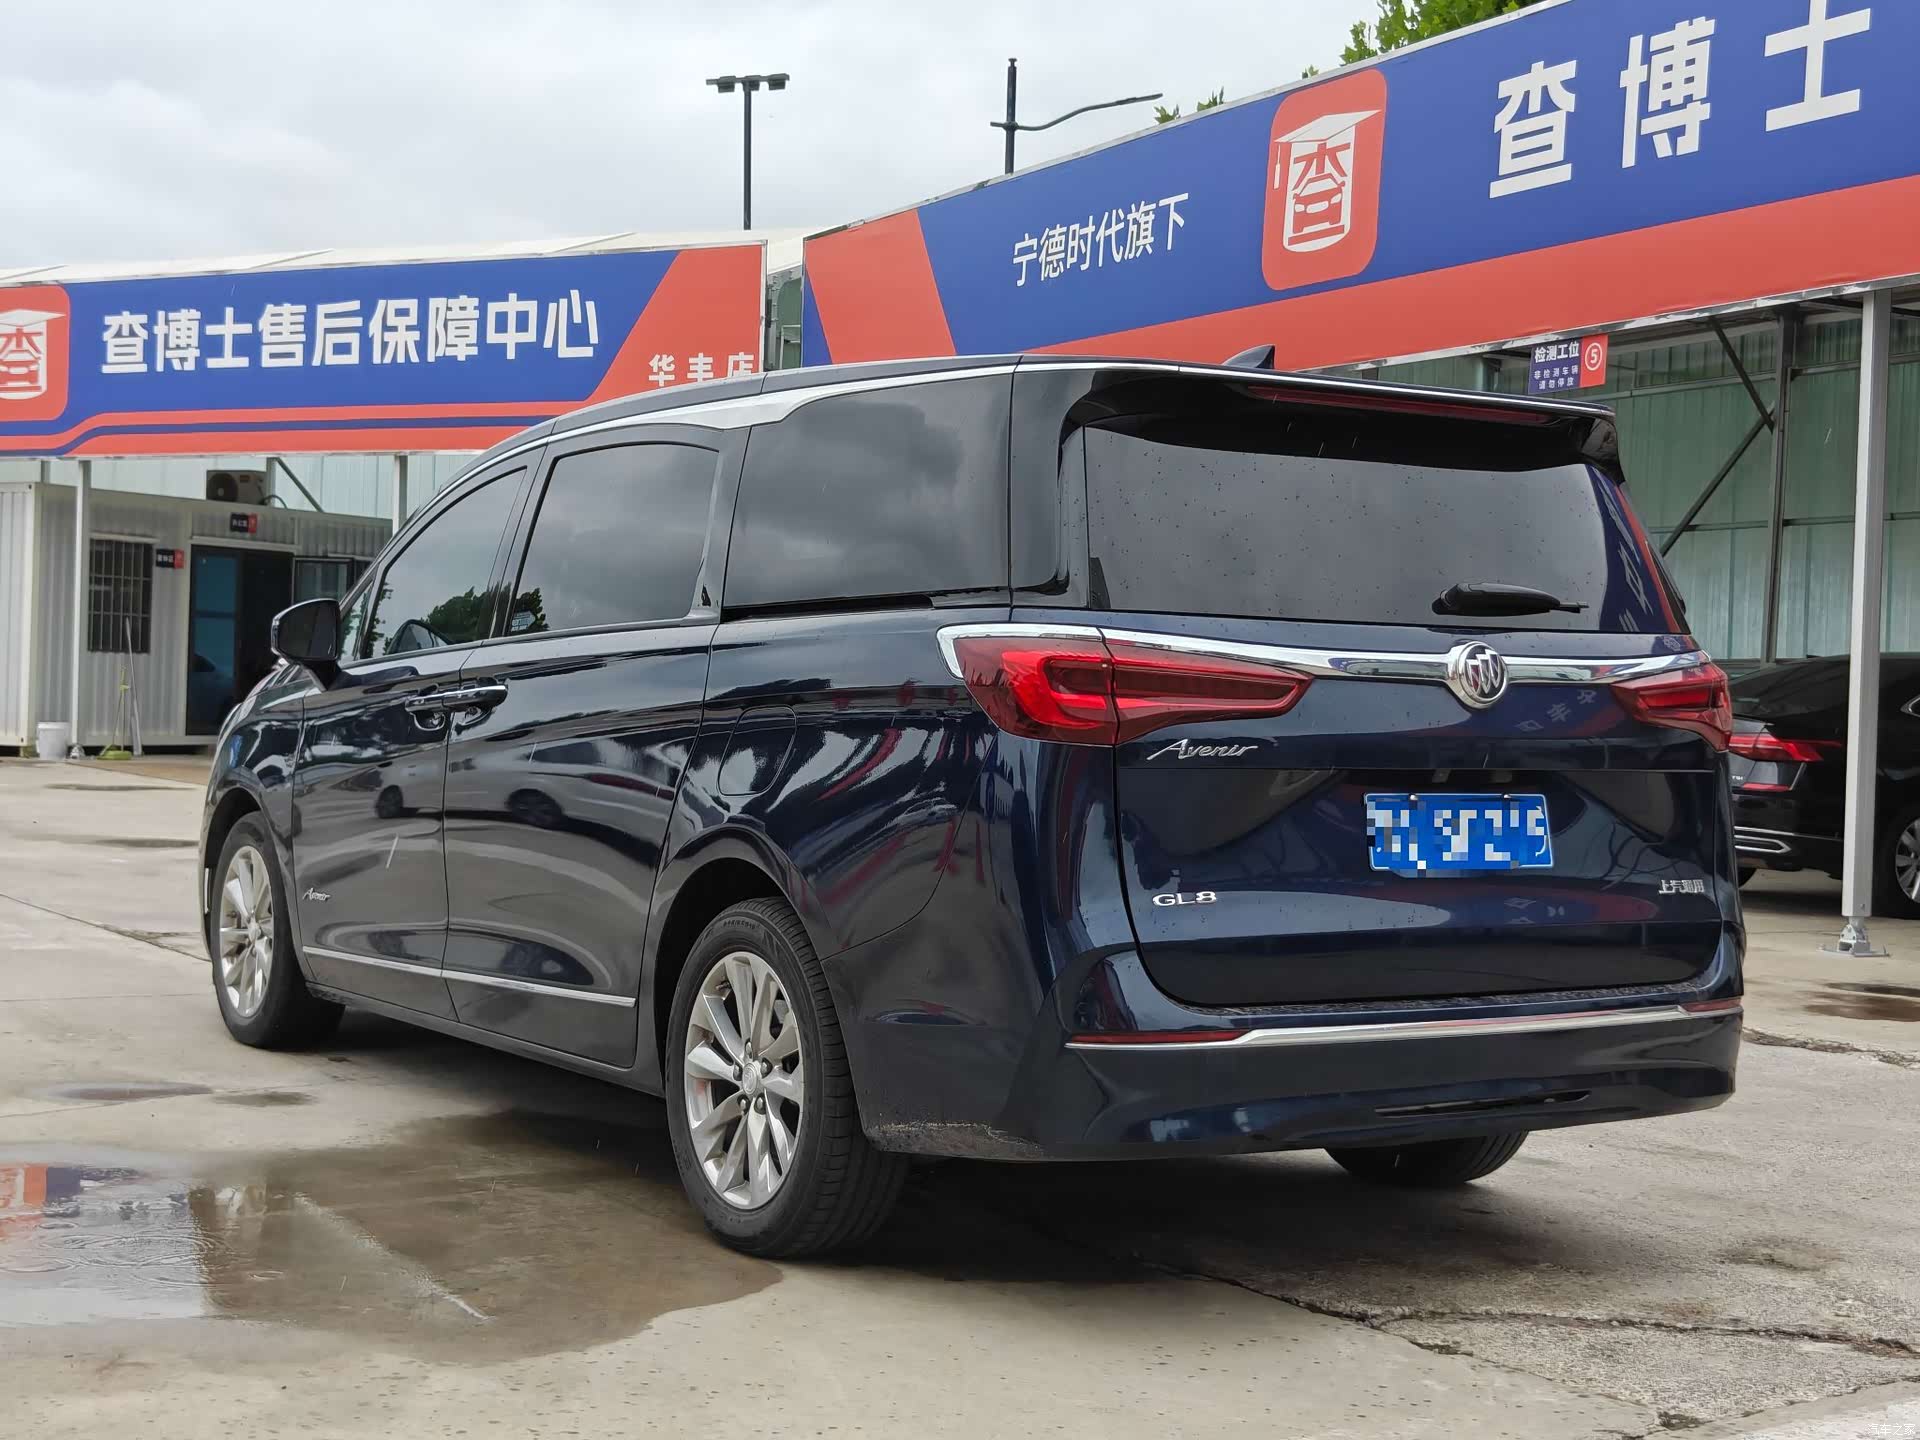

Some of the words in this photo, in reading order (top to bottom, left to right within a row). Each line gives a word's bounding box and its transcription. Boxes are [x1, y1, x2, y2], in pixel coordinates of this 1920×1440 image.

[1489, 0, 1871, 199] 查博士
[1012, 192, 1189, 287] 宁德时代旗下
[101, 289, 599, 374] 查博士售后保障中心
[1534, 341, 1580, 363] 检测工位
[648, 351, 755, 387] 华丰店
[1534, 364, 1579, 380] 非检测车辆
[1538, 377, 1574, 390] 请勿停放
[1147, 738, 1259, 760] Avenir
[1152, 891, 1217, 907] GL8
